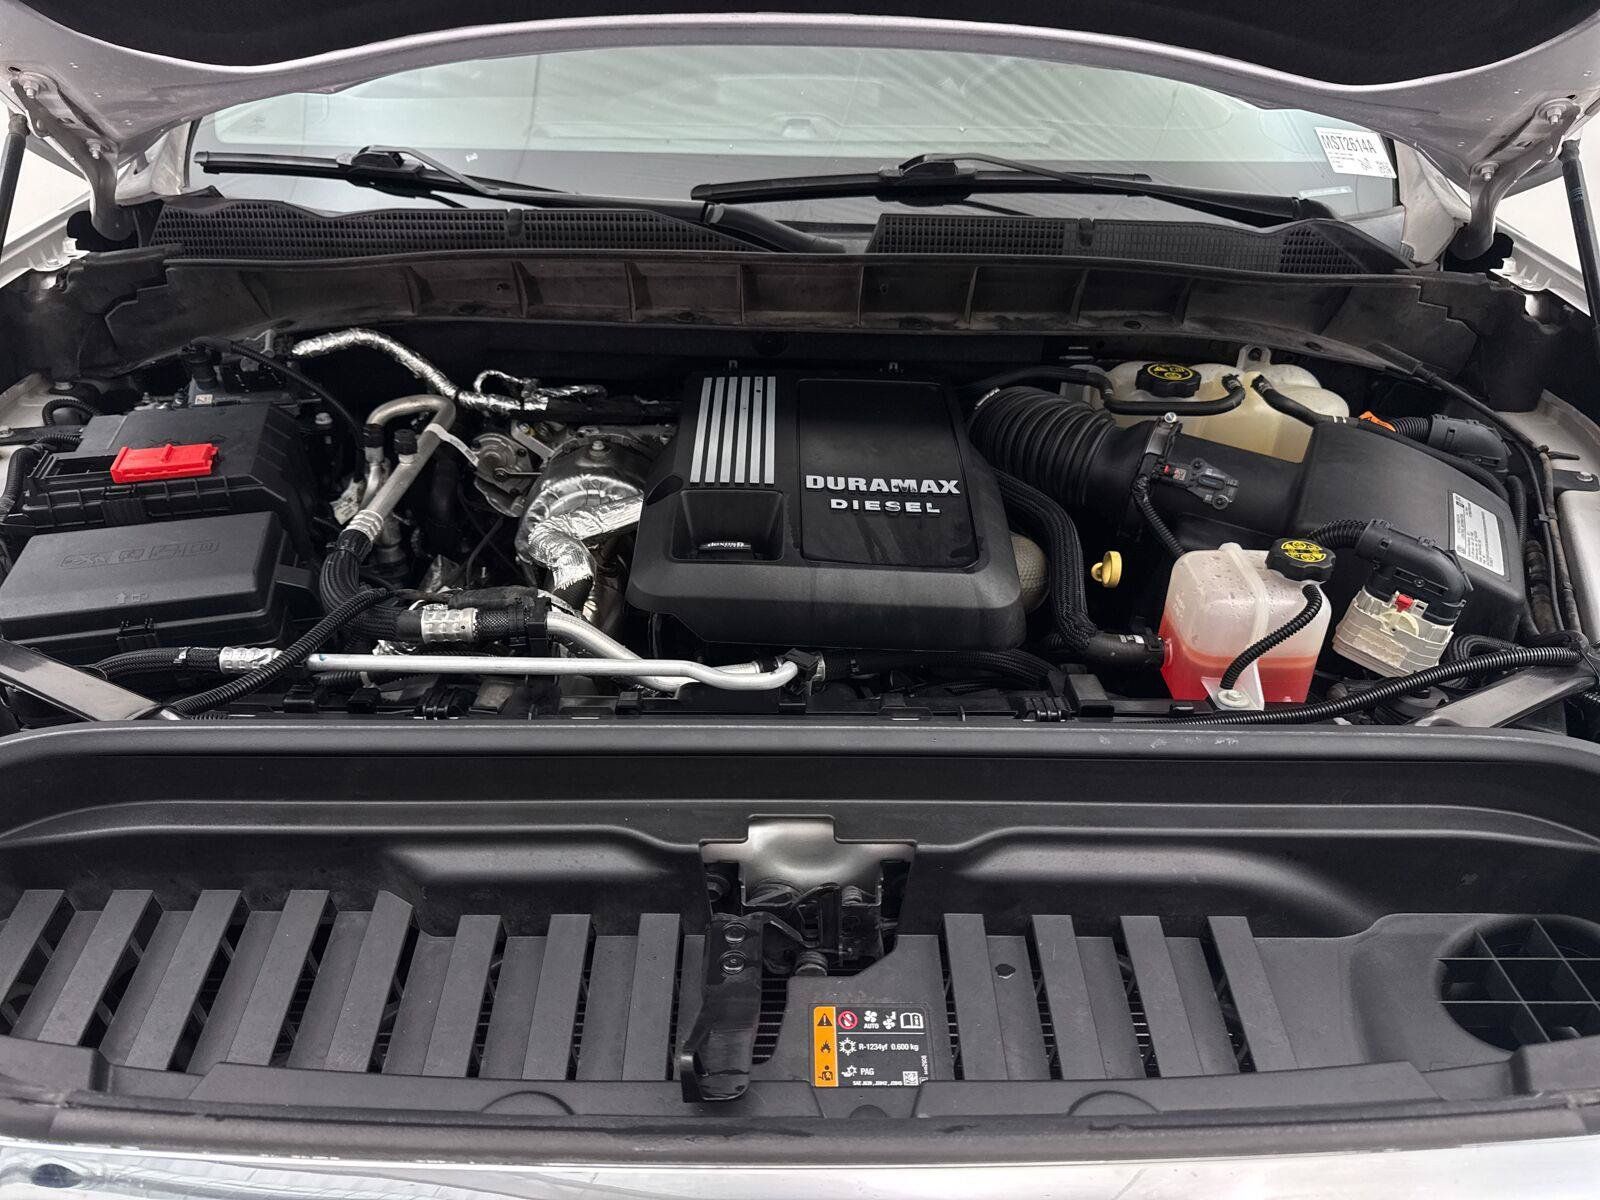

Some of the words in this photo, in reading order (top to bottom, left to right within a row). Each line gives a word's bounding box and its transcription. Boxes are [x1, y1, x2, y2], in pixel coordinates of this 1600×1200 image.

[1321, 135, 1377, 153] MST2614A
[805, 475, 960, 494] DURAMAX
[830, 498, 941, 514] DIESEL
[858, 1043, 888, 1051] R-1234yf
[890, 1043, 909, 1051] 0.600
[910, 1043, 919, 1052] kg
[860, 1067, 875, 1076] PAG
